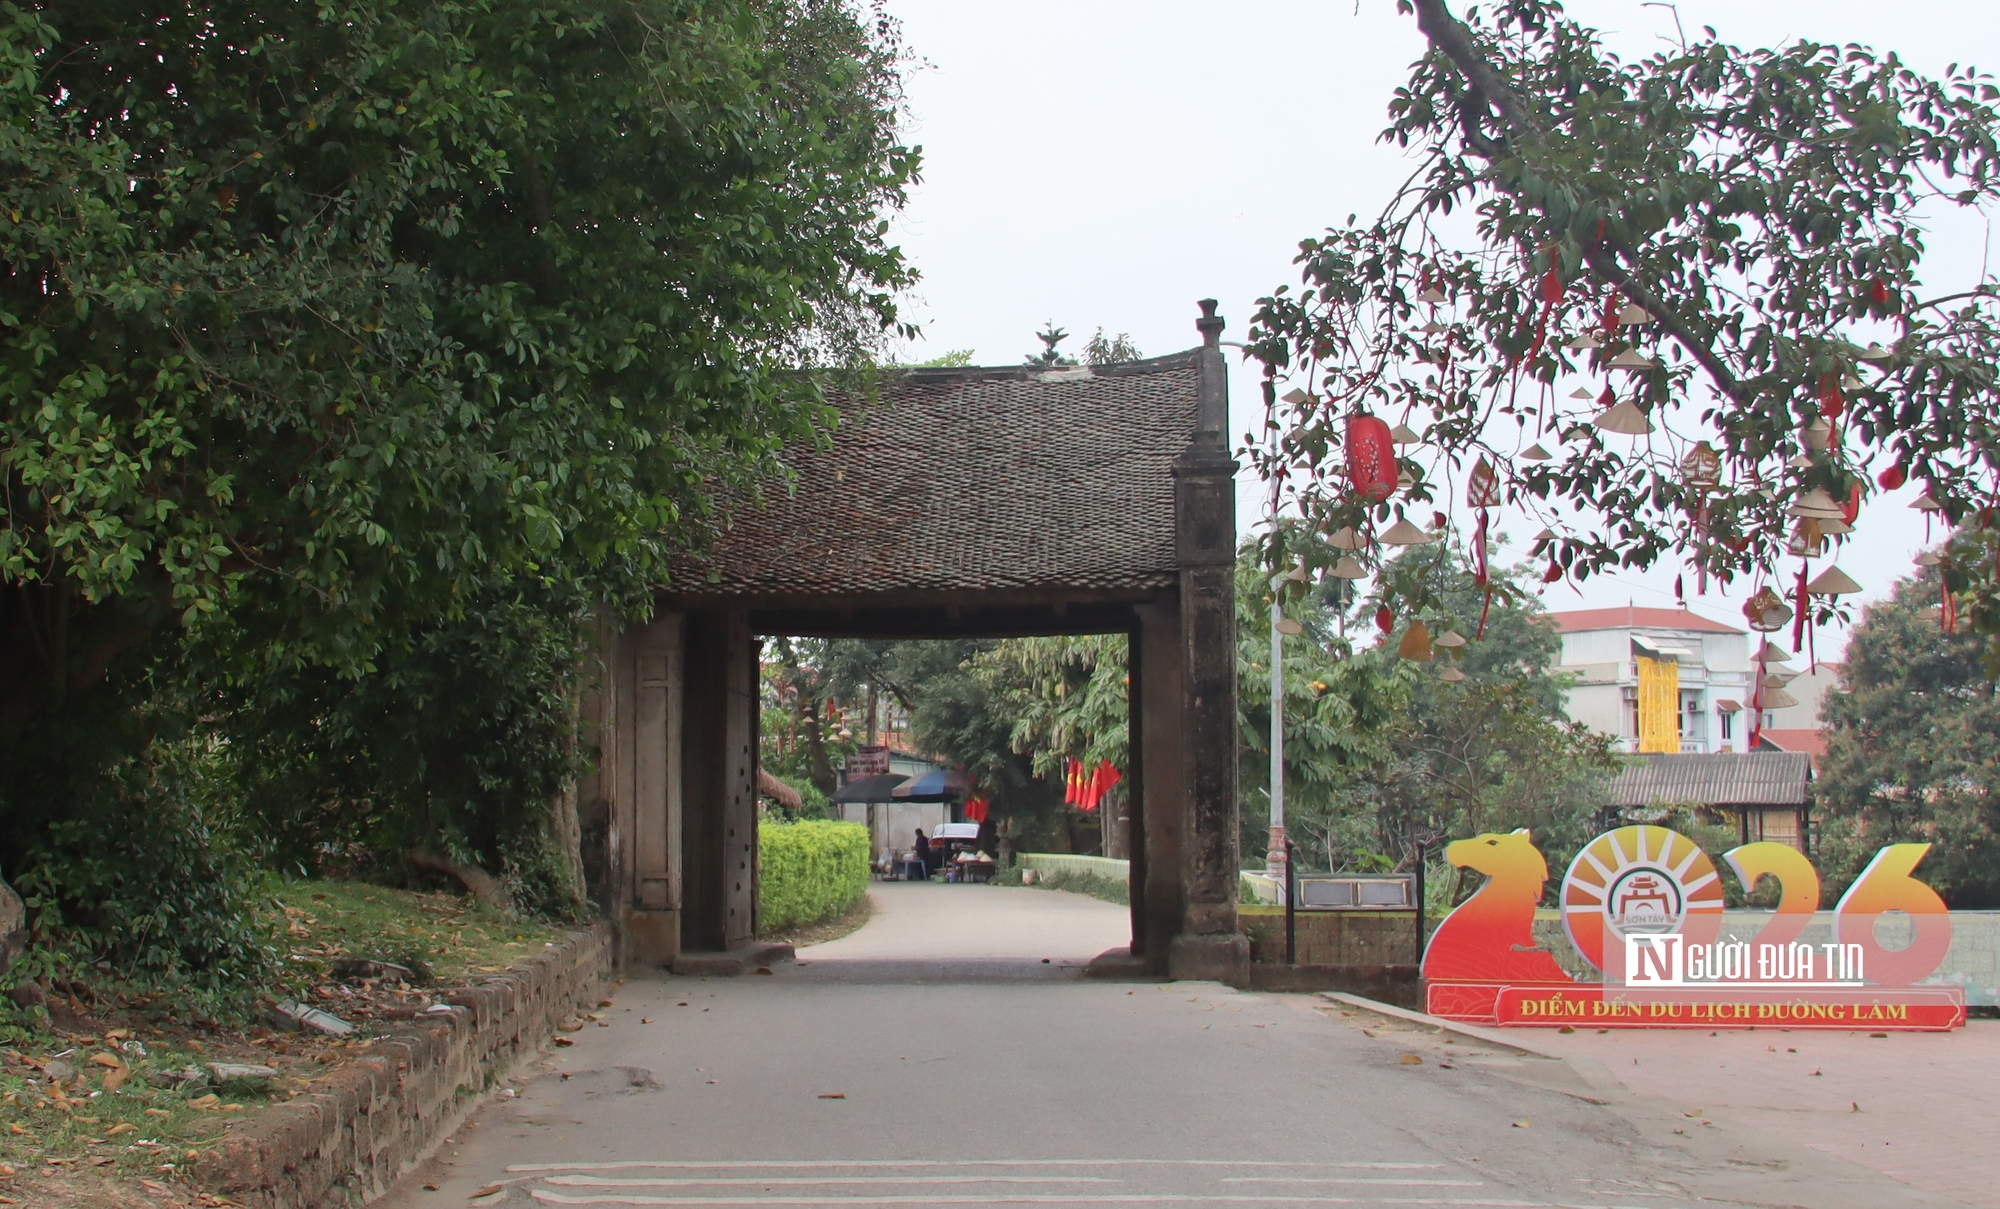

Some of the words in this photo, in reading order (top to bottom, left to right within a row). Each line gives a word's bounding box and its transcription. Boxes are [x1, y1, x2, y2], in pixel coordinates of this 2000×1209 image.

[1625, 914, 1646, 925] SƠN
[1520, 991, 1586, 1017] ĐIỂM
[1592, 993, 1643, 1018] ĐẾN
[1650, 1000, 1684, 1018] DU
[1690, 1001, 1751, 1022] LỊCH
[1757, 997, 1846, 1020] ĐƯỜNG
[1852, 998, 1908, 1020] LÂM
